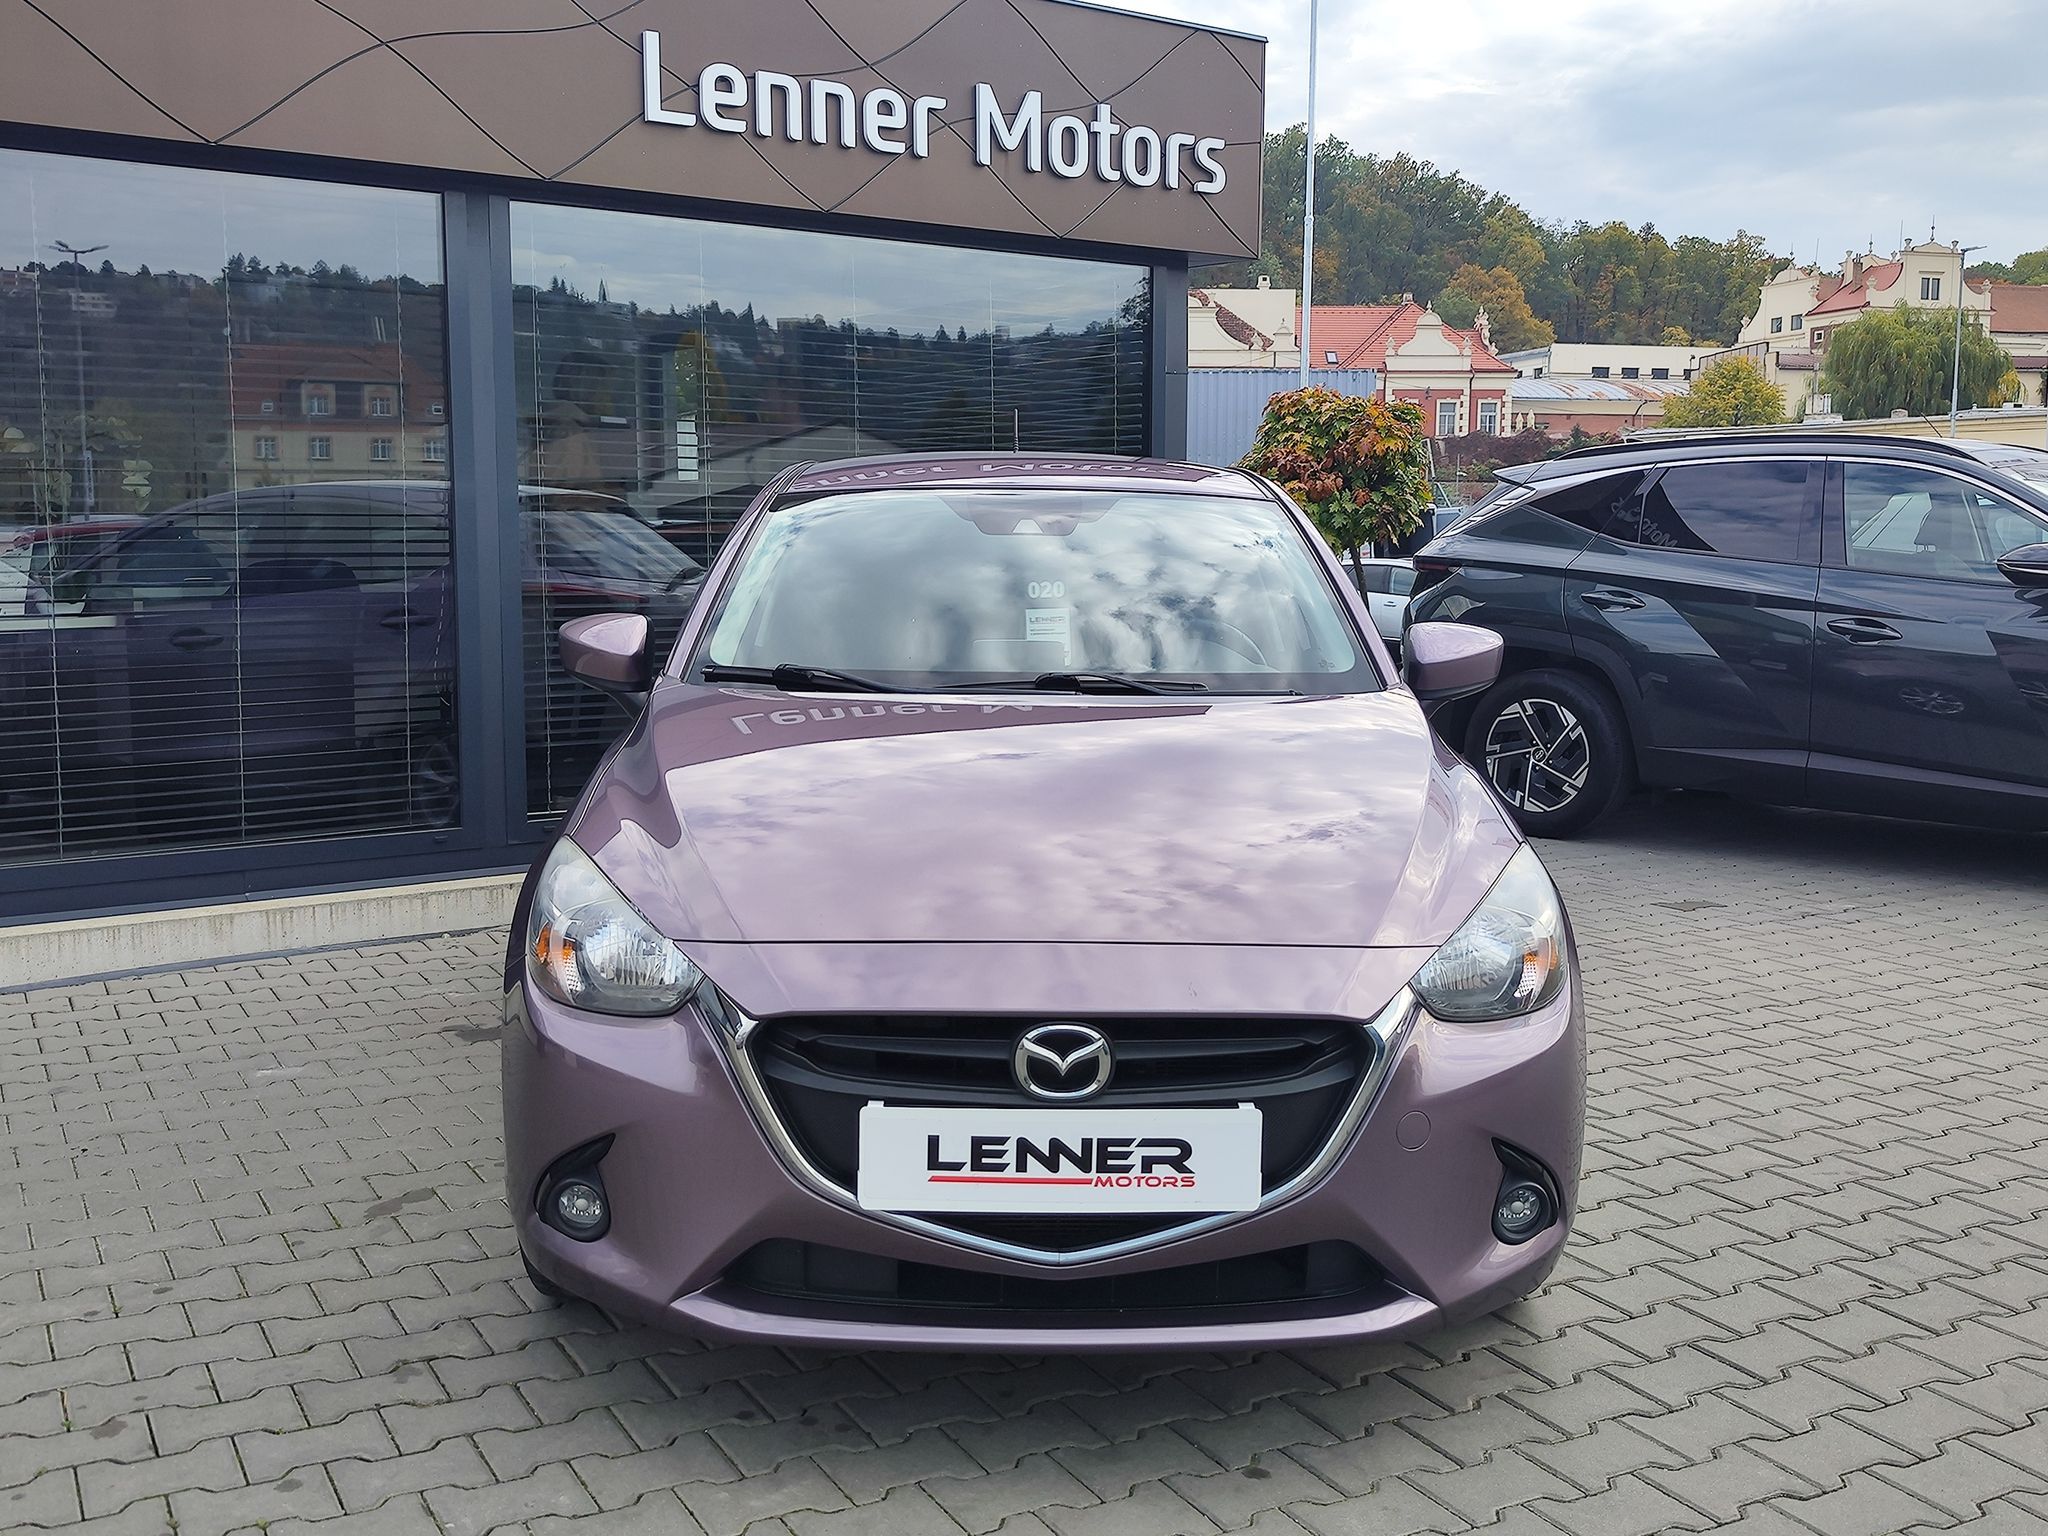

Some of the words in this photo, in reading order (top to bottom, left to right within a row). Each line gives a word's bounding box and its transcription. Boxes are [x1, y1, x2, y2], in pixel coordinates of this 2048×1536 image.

[641, 29, 947, 160] Lenner
[974, 82, 1227, 195] Motors
[1027, 581, 1065, 599] 020
[926, 1134, 1196, 1174] LENNER
[1093, 1175, 1196, 1188] MOTORS
